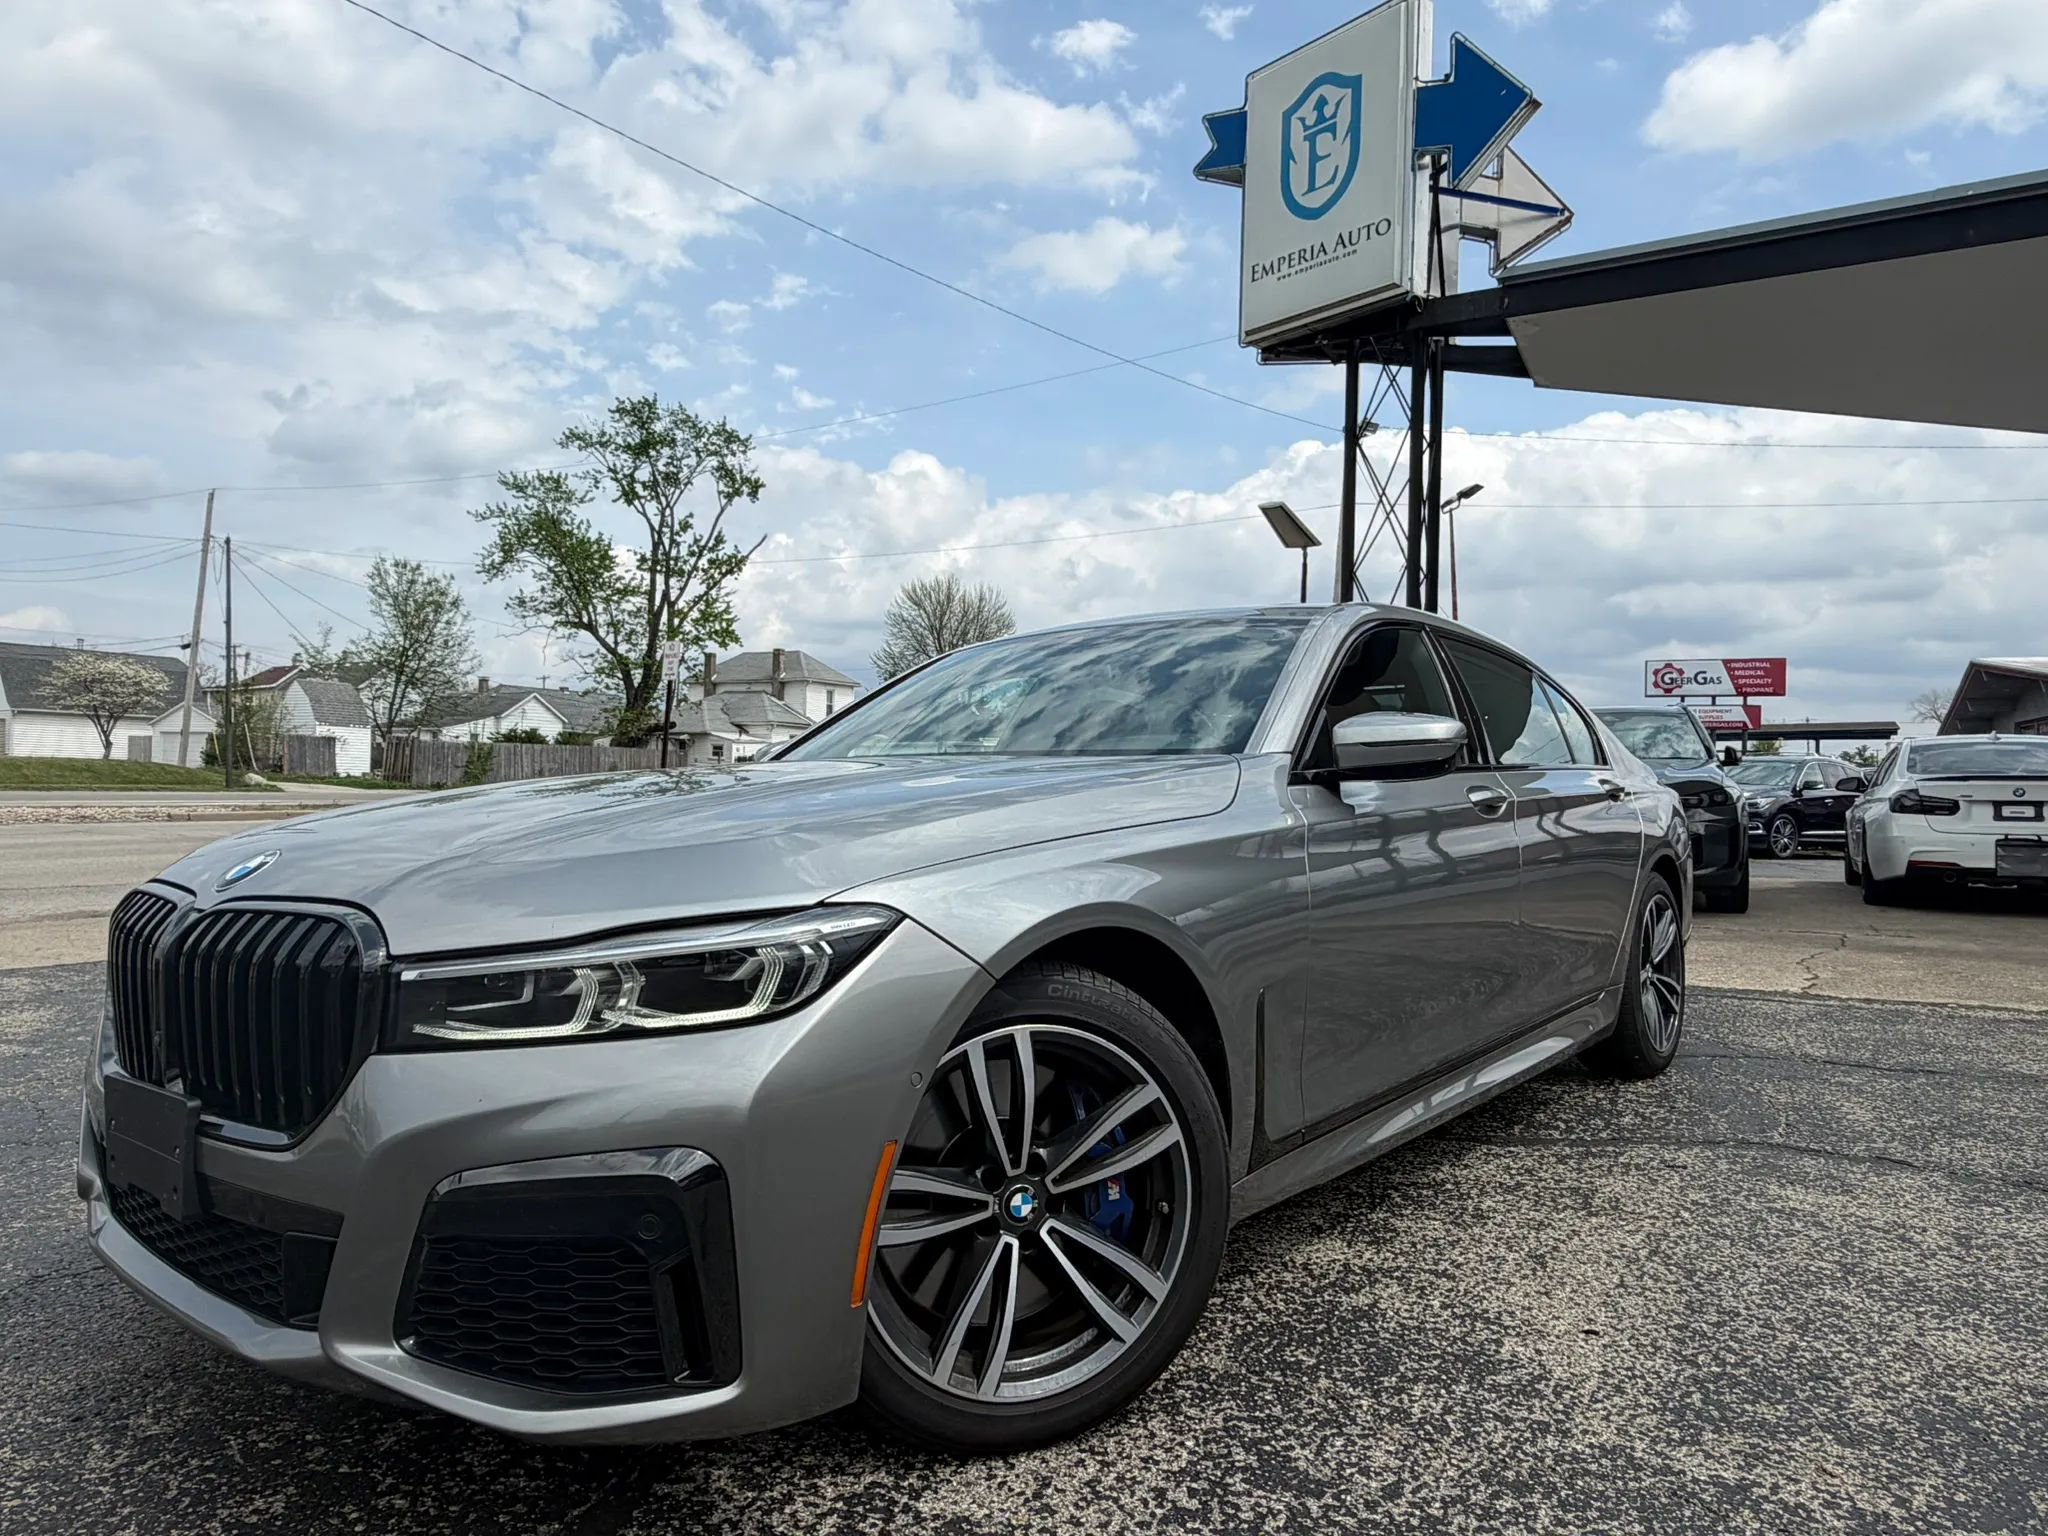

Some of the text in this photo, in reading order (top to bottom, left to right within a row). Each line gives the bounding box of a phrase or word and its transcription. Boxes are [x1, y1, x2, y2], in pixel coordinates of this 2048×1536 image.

[1250, 218, 1392, 283] EMPERIA AUTO
[1276, 249, 1358, 281] www.emperiaauto.com
